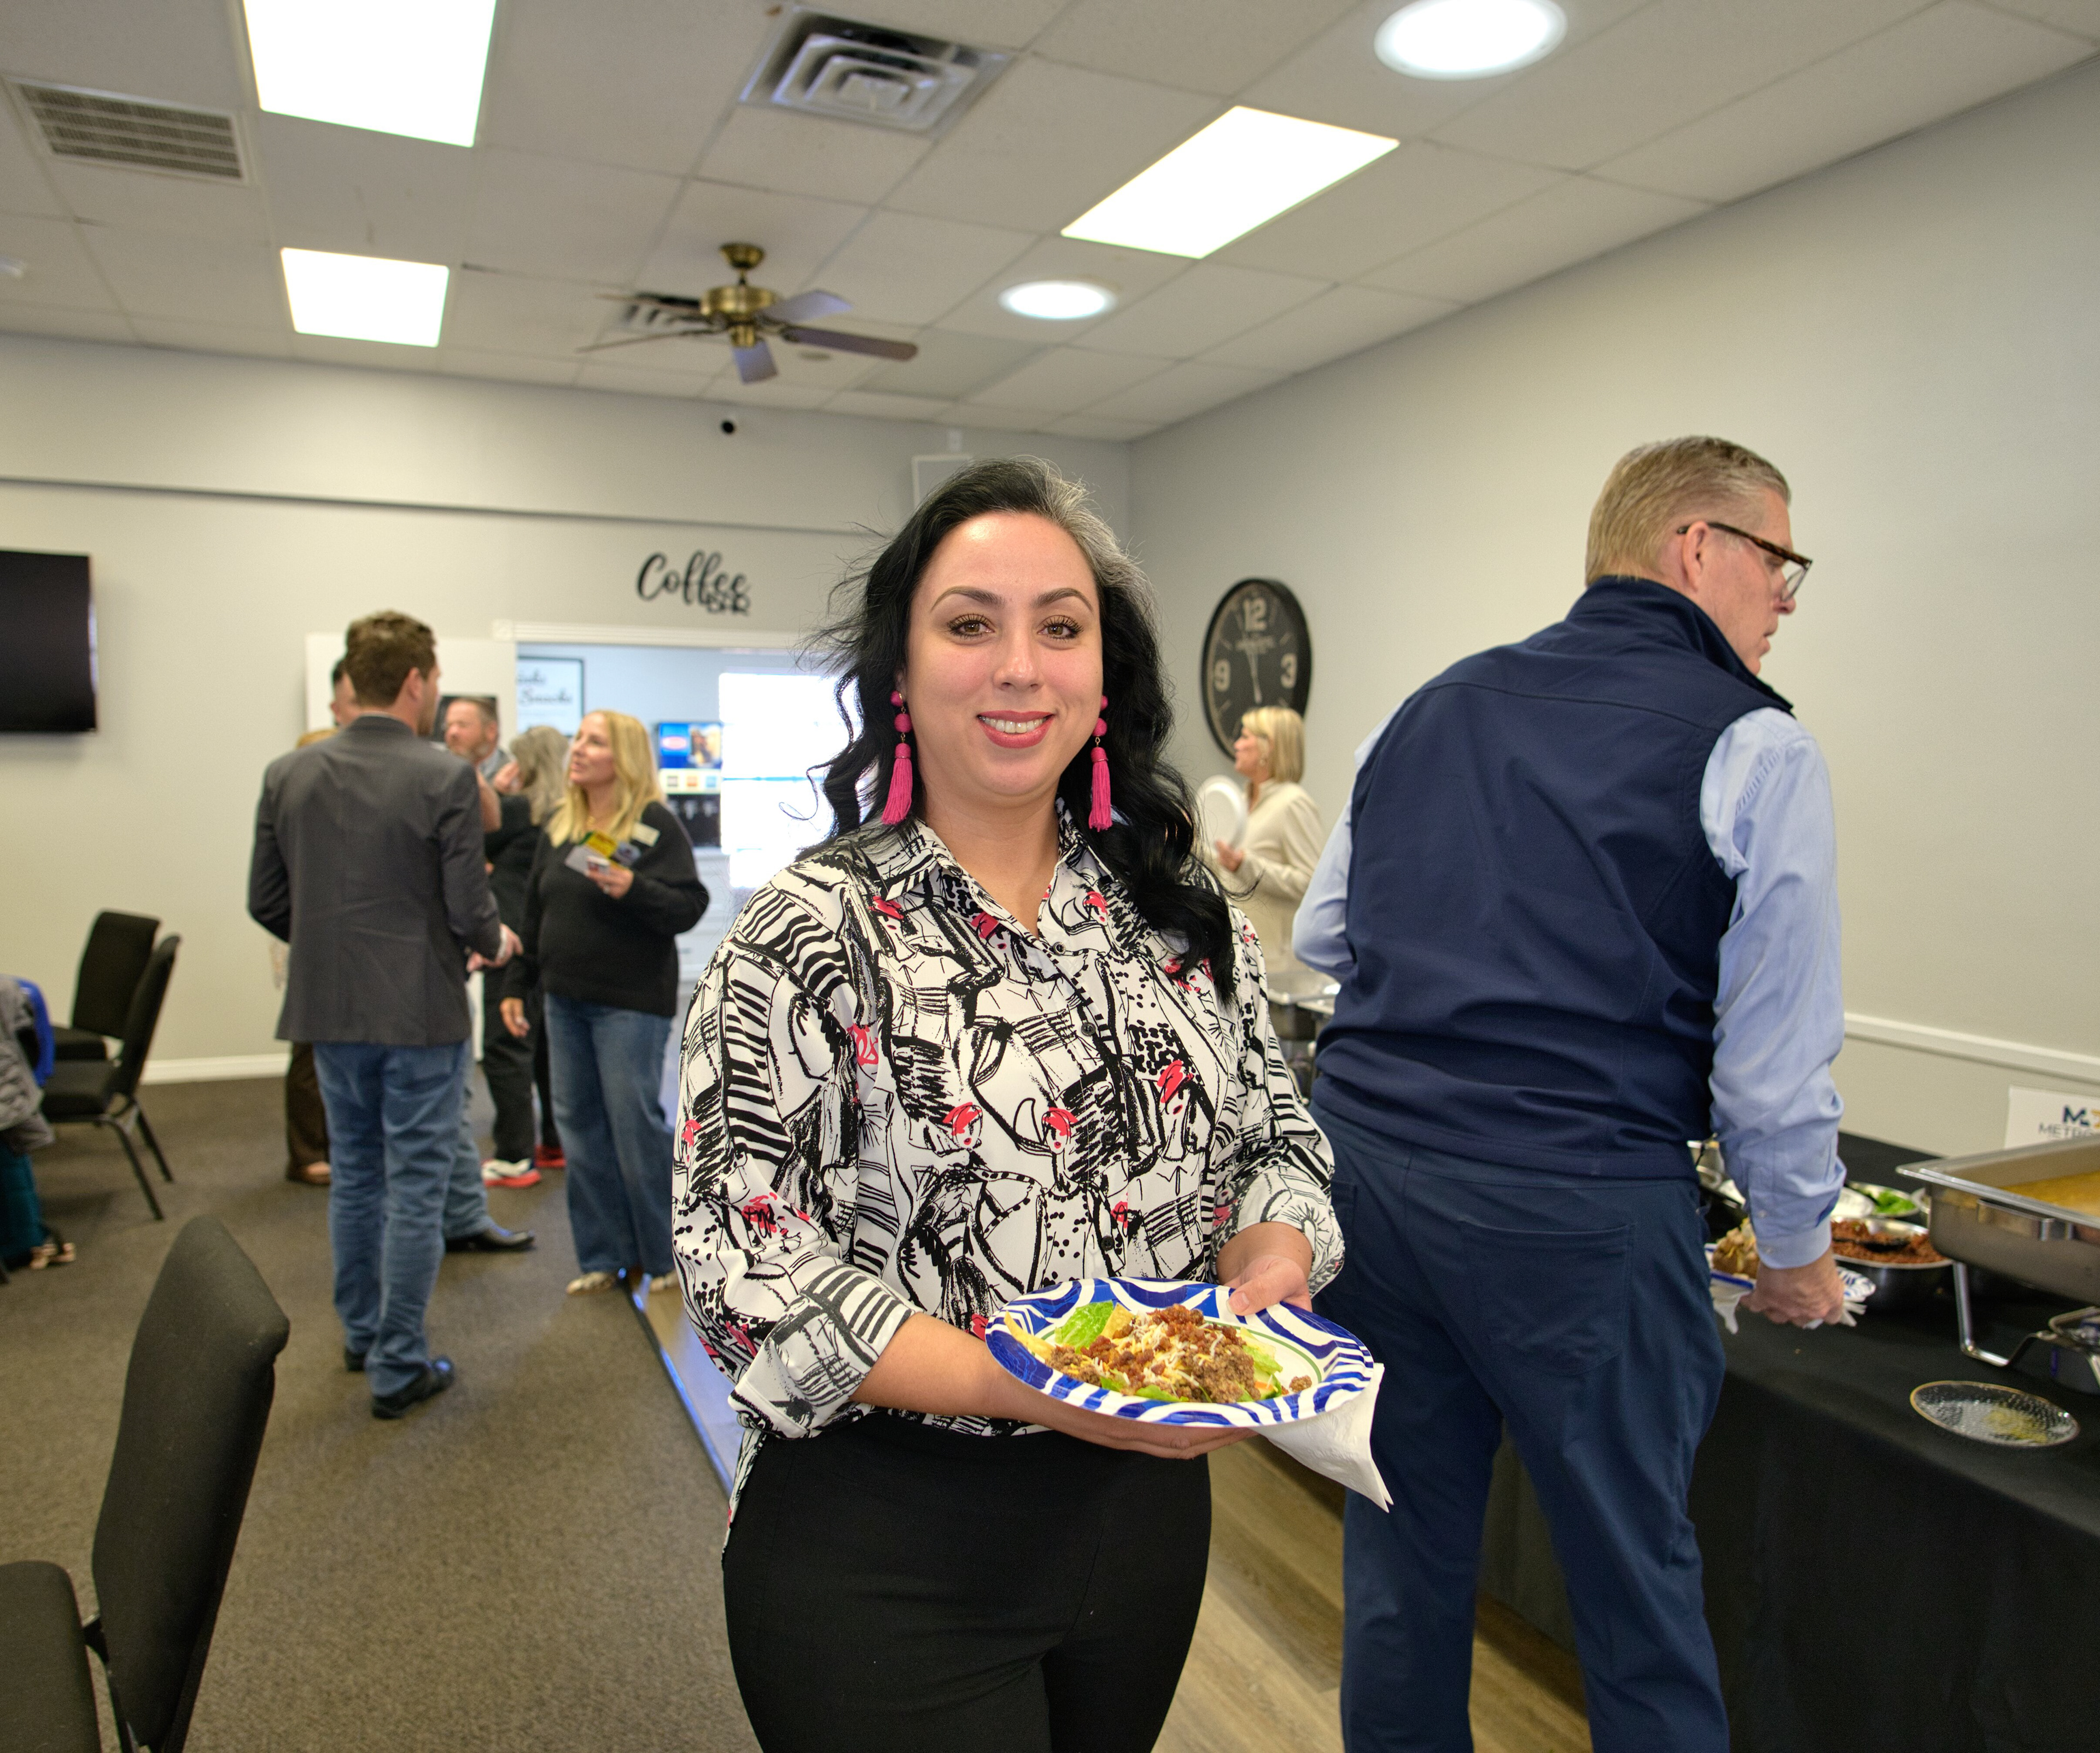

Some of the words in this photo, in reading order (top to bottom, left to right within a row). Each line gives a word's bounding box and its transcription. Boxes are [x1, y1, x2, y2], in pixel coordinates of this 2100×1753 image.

[637, 549, 750, 605] Coffee
[1242, 597, 1267, 633] 12
[1214, 658, 1230, 692] 9
[1280, 653, 1297, 689] 3
